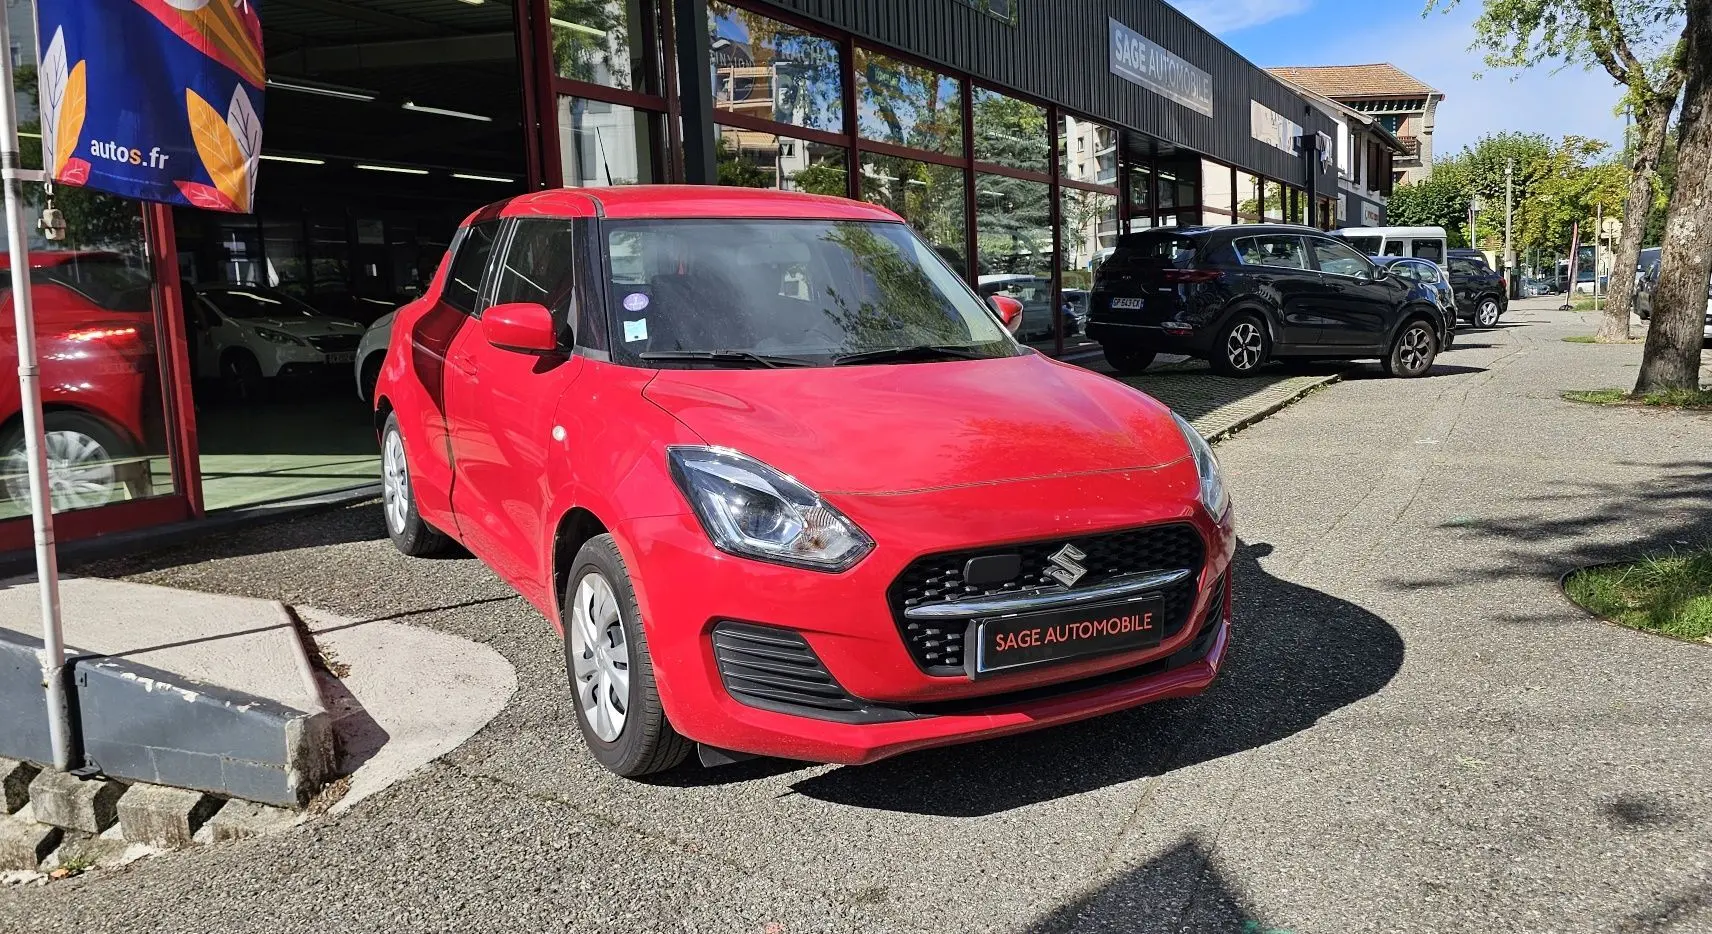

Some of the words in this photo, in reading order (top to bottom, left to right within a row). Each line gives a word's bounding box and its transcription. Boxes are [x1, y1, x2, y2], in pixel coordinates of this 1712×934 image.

[1115, 29, 1147, 73] SAGE
[1148, 48, 1209, 104] AUTOMOBILE
[90, 139, 169, 169] autos.fr
[995, 628, 1041, 651] SAGE
[1044, 613, 1153, 644] AUTOMOBILE
